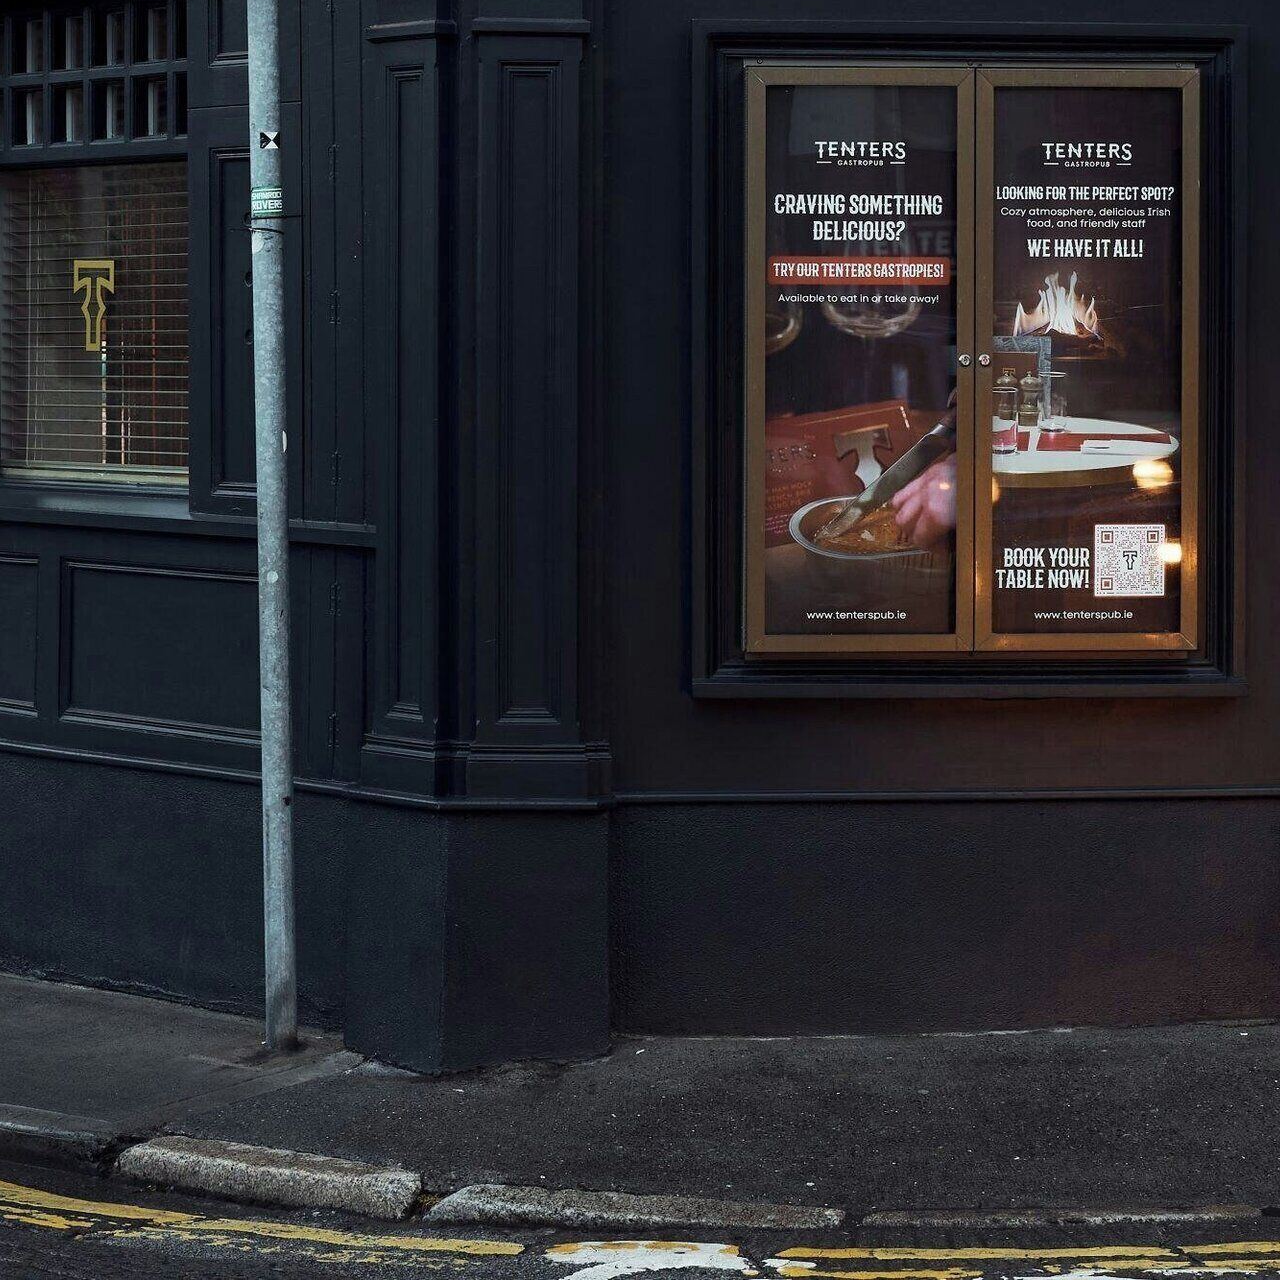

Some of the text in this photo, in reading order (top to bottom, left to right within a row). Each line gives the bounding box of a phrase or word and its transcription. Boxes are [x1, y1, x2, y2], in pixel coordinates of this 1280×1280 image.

[814, 141, 906, 160] TENTERS
[1042, 143, 1133, 160] TENTERS
[996, 186, 1175, 201] LOOKING FOR THE PERFECT SPOT?
[251, 200, 283, 210] ROVERS
[774, 194, 943, 216] CRAVING SOMETHING
[1000, 207, 1171, 217] Cozy atmosphere, delicious Irish
[812, 220, 906, 241] DELICIOUS?
[1026, 219, 1146, 229] food, and friendly staff
[1027, 239, 1144, 257] WE HAVE IT ALL!
[773, 262, 944, 278] TRY OUR TENTERS GASTROPIES!
[778, 293, 939, 304] Available to eat in or take away!
[1004, 547, 1090, 568] BOOK YOUR
[995, 569, 1090, 589] TABLE NOW!
[806, 610, 907, 620] www.tenterspub.ie
[1034, 610, 1133, 620] www.tenterspub.ie
